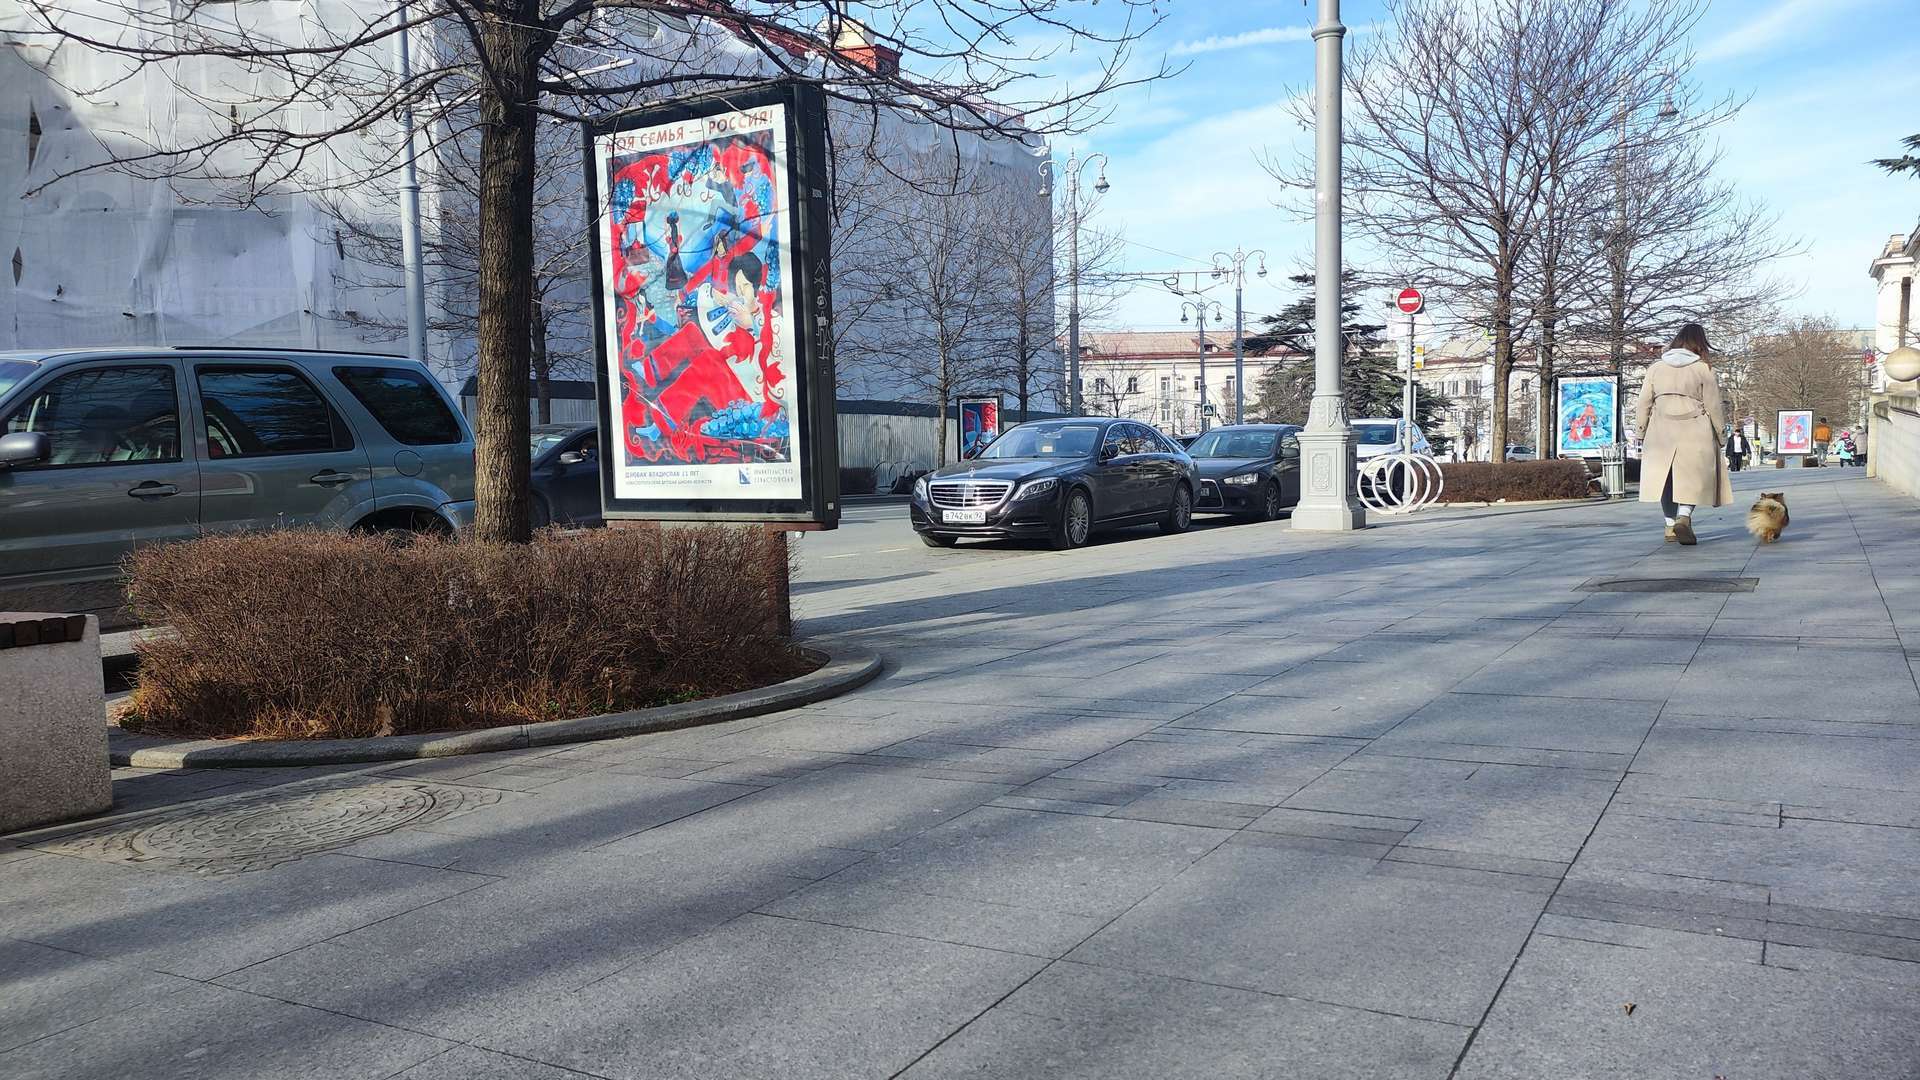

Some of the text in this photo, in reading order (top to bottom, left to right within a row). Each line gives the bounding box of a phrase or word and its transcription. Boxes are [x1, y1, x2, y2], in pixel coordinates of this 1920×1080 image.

[605, 135, 635, 153] МОЯ
[640, 127, 684, 147] СЕМЬЯ
[709, 109, 773, 135] РОССИЯ!
